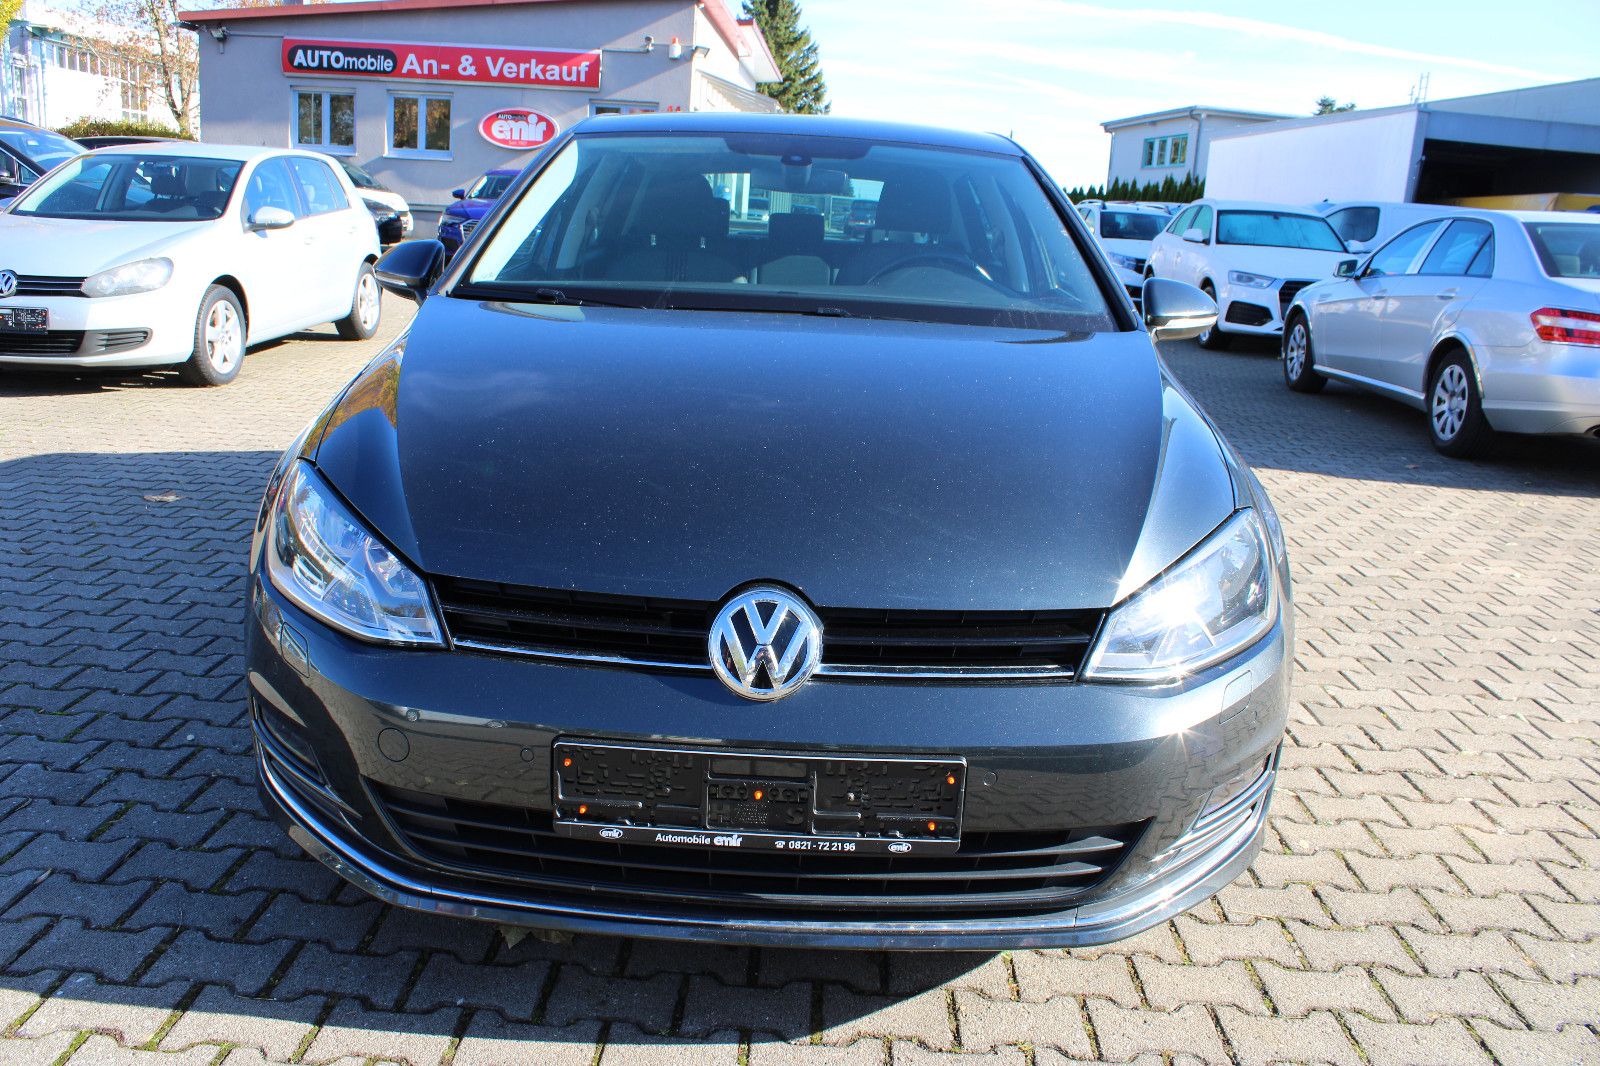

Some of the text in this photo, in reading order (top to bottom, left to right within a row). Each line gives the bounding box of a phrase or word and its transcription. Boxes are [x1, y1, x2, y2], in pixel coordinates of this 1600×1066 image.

[293, 49, 590, 82] AUTOmobile An- & Verkauf
[491, 113, 547, 141] emir
[655, 833, 743, 847] Automobile emir
[788, 840, 811, 850] 0821
